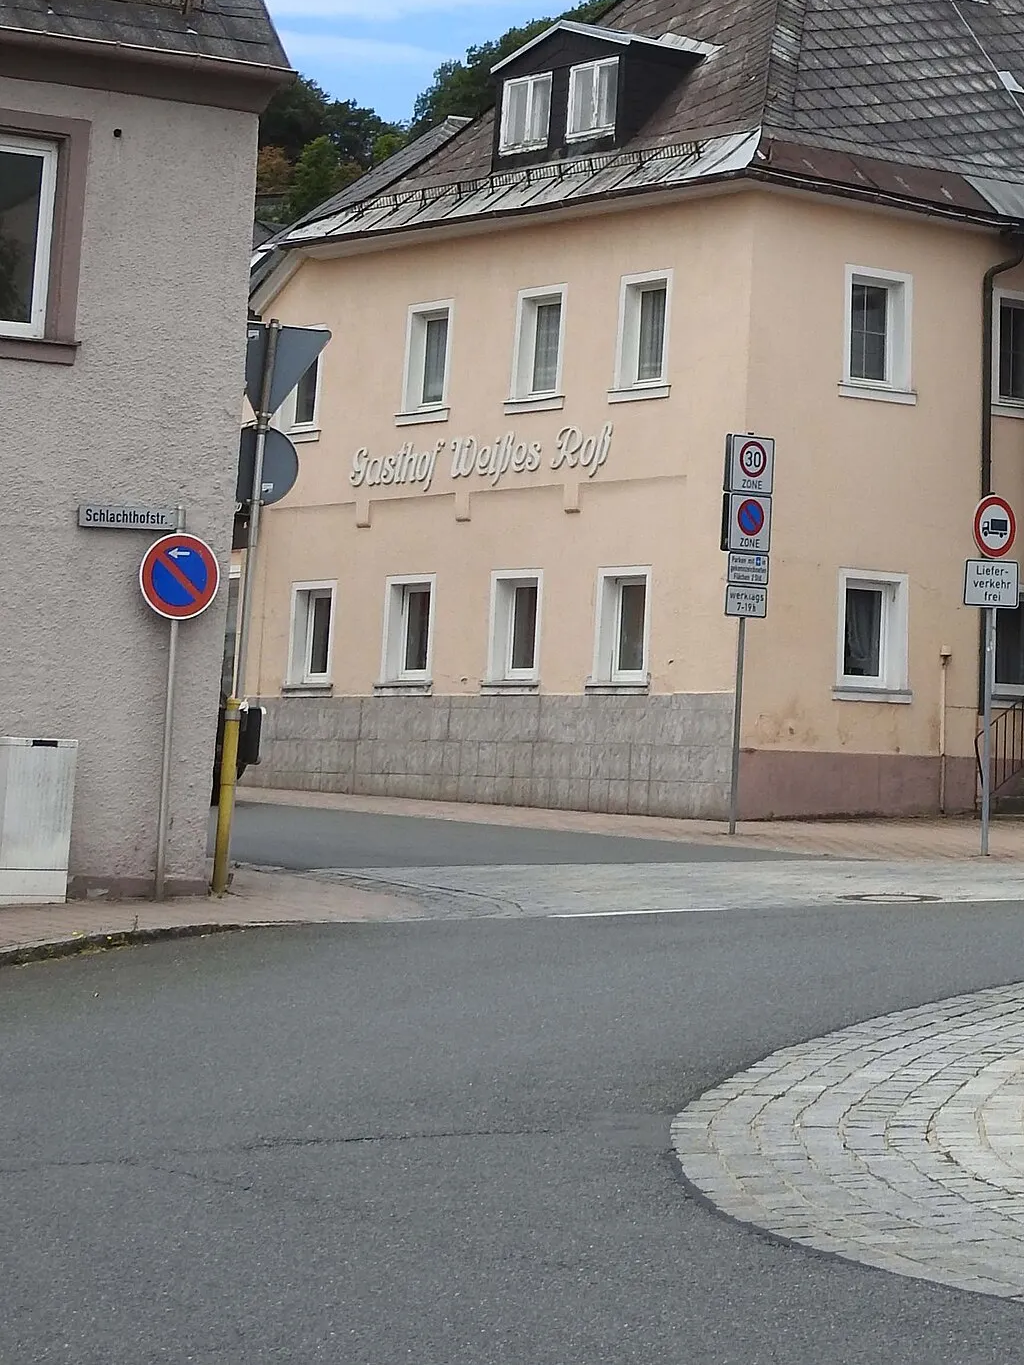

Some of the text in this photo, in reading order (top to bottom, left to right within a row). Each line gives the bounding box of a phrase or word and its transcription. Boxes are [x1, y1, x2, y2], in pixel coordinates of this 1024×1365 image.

[350, 421, 614, 492] Gasthof Weißes Roß
[745, 450, 762, 468] 30
[742, 479, 763, 490] ZONE
[85, 508, 168, 525] Schlachthofstr.
[740, 537, 761, 548] ZONE
[976, 565, 1009, 576] Liefer-
[973, 579, 1011, 589] verkehr
[984, 591, 1001, 602] frei
